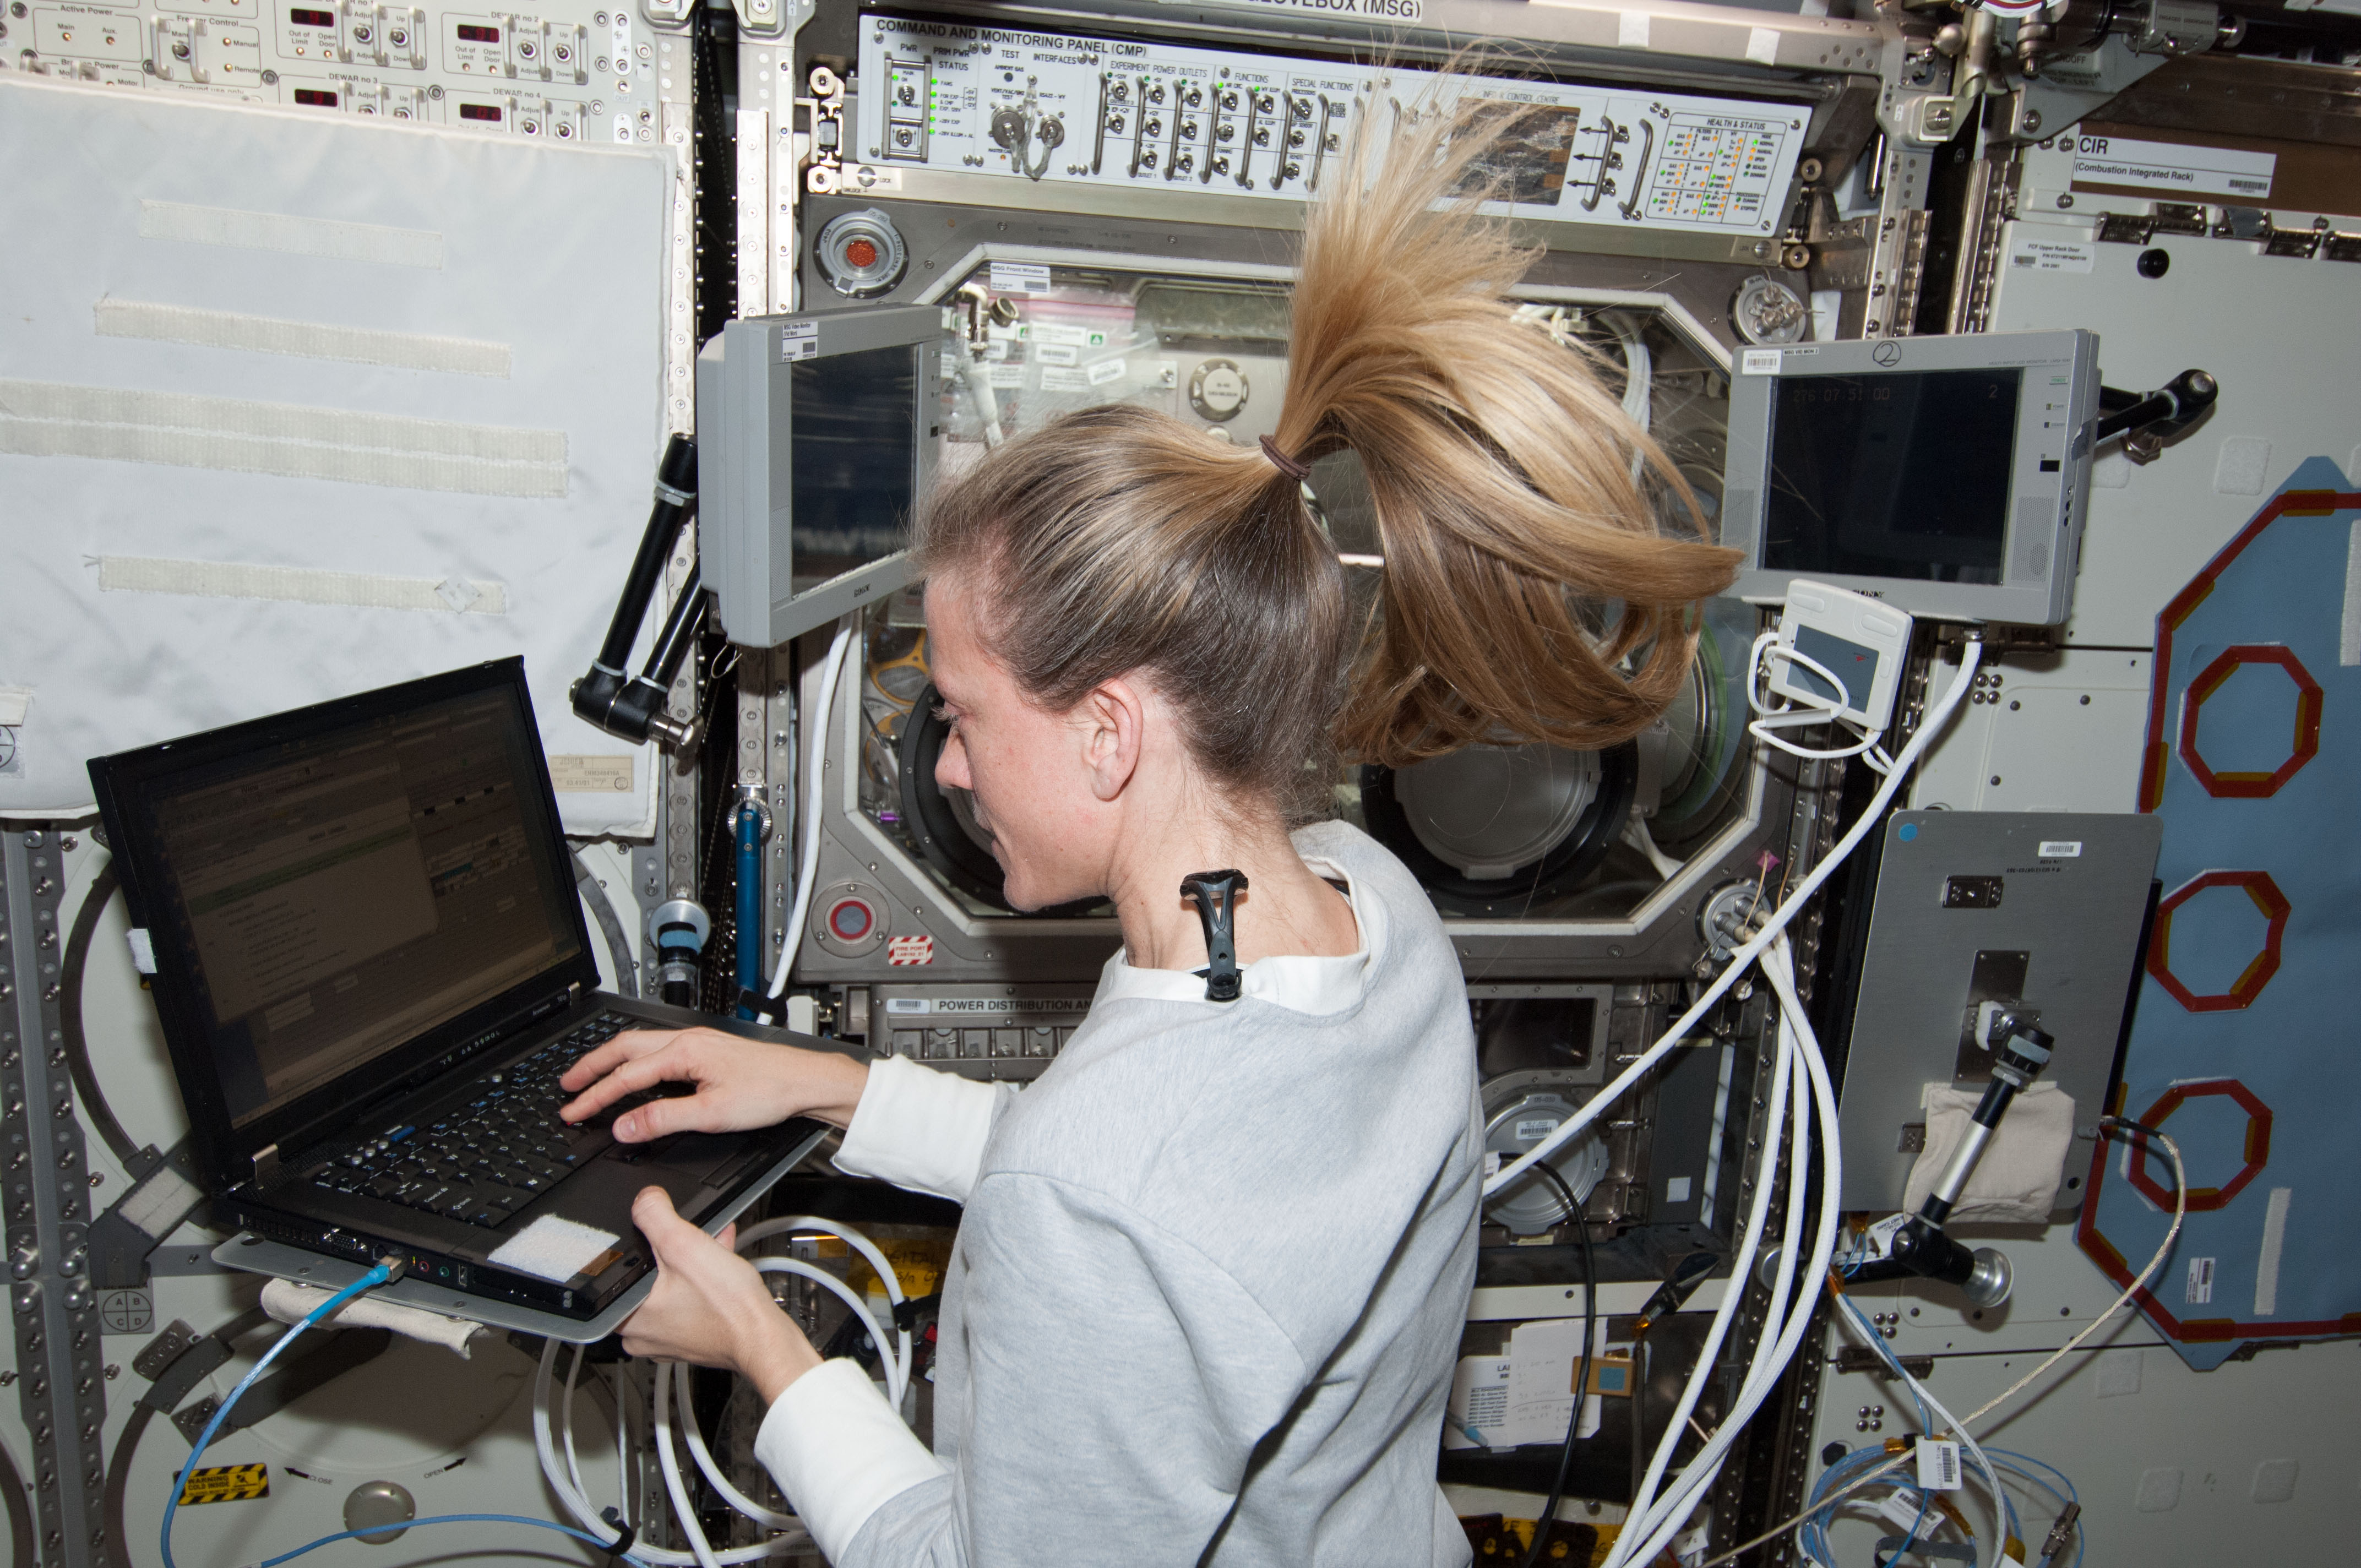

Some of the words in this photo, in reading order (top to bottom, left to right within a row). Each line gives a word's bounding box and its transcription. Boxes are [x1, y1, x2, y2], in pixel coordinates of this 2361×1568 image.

[60, 5, 85, 13] Active
[88, 7, 113, 15] Power
[1363, 0, 1421, 18] (MSG)
[209, 18, 238, 27] Control
[877, 19, 946, 37] COMMAND
[949, 28, 977, 40] AND
[981, 30, 1063, 48] MONITORING
[1068, 39, 1108, 53] PANEL
[1112, 43, 1146, 57] (CMP)
[900, 43, 918, 53] PWR
[933, 46, 951, 56] PRIM
[953, 48, 971, 58] PWR
[1002, 50, 1020, 59] TEST
[1033, 53, 1076, 64] INTERFACES
[235, 66, 260, 74] Remote
[938, 61, 969, 71] STATUS
[1110, 61, 1150, 71] EXPERIMENT
[1153, 65, 1176, 75] POWER
[1179, 67, 1207, 78] OUTLETS
[329, 73, 358, 82] DEWAR
[1234, 73, 1269, 83] FUNCTIONS
[1292, 78, 1316, 88] SPECIAL
[1321, 81, 1354, 91] FUNCTIONS
[493, 88, 522, 96] DEWAR
[1507, 92, 1533, 102] CONTROL
[1537, 95, 1560, 105] CENTRE
[1706, 118, 1733, 127] HEALTH
[1733, 119, 1738, 128] &
[1739, 122, 1766, 130] STATUS
[2079, 137, 2109, 155] CIR
[2075, 162, 2127, 176] (Combustion
[2128, 167, 2169, 179] Integrated
[2170, 171, 2194, 183] Rack)
[1881, 343, 1897, 364] 2
[1824, 388, 1841, 401] 07
[1873, 388, 1891, 400] 00
[1989, 384, 1998, 399] 2
[939, 1000, 984, 1011] POWER
[988, 1000, 1073, 1011] DISTRIBUTION
[116, 1298, 123, 1306] A
[133, 1297, 140, 1306] B
[135, 1317, 142, 1326] D
[424, 1468, 444, 1479] OPEN
[188, 1476, 229, 1484] WARNING
[309, 1474, 334, 1485] CLOSE
